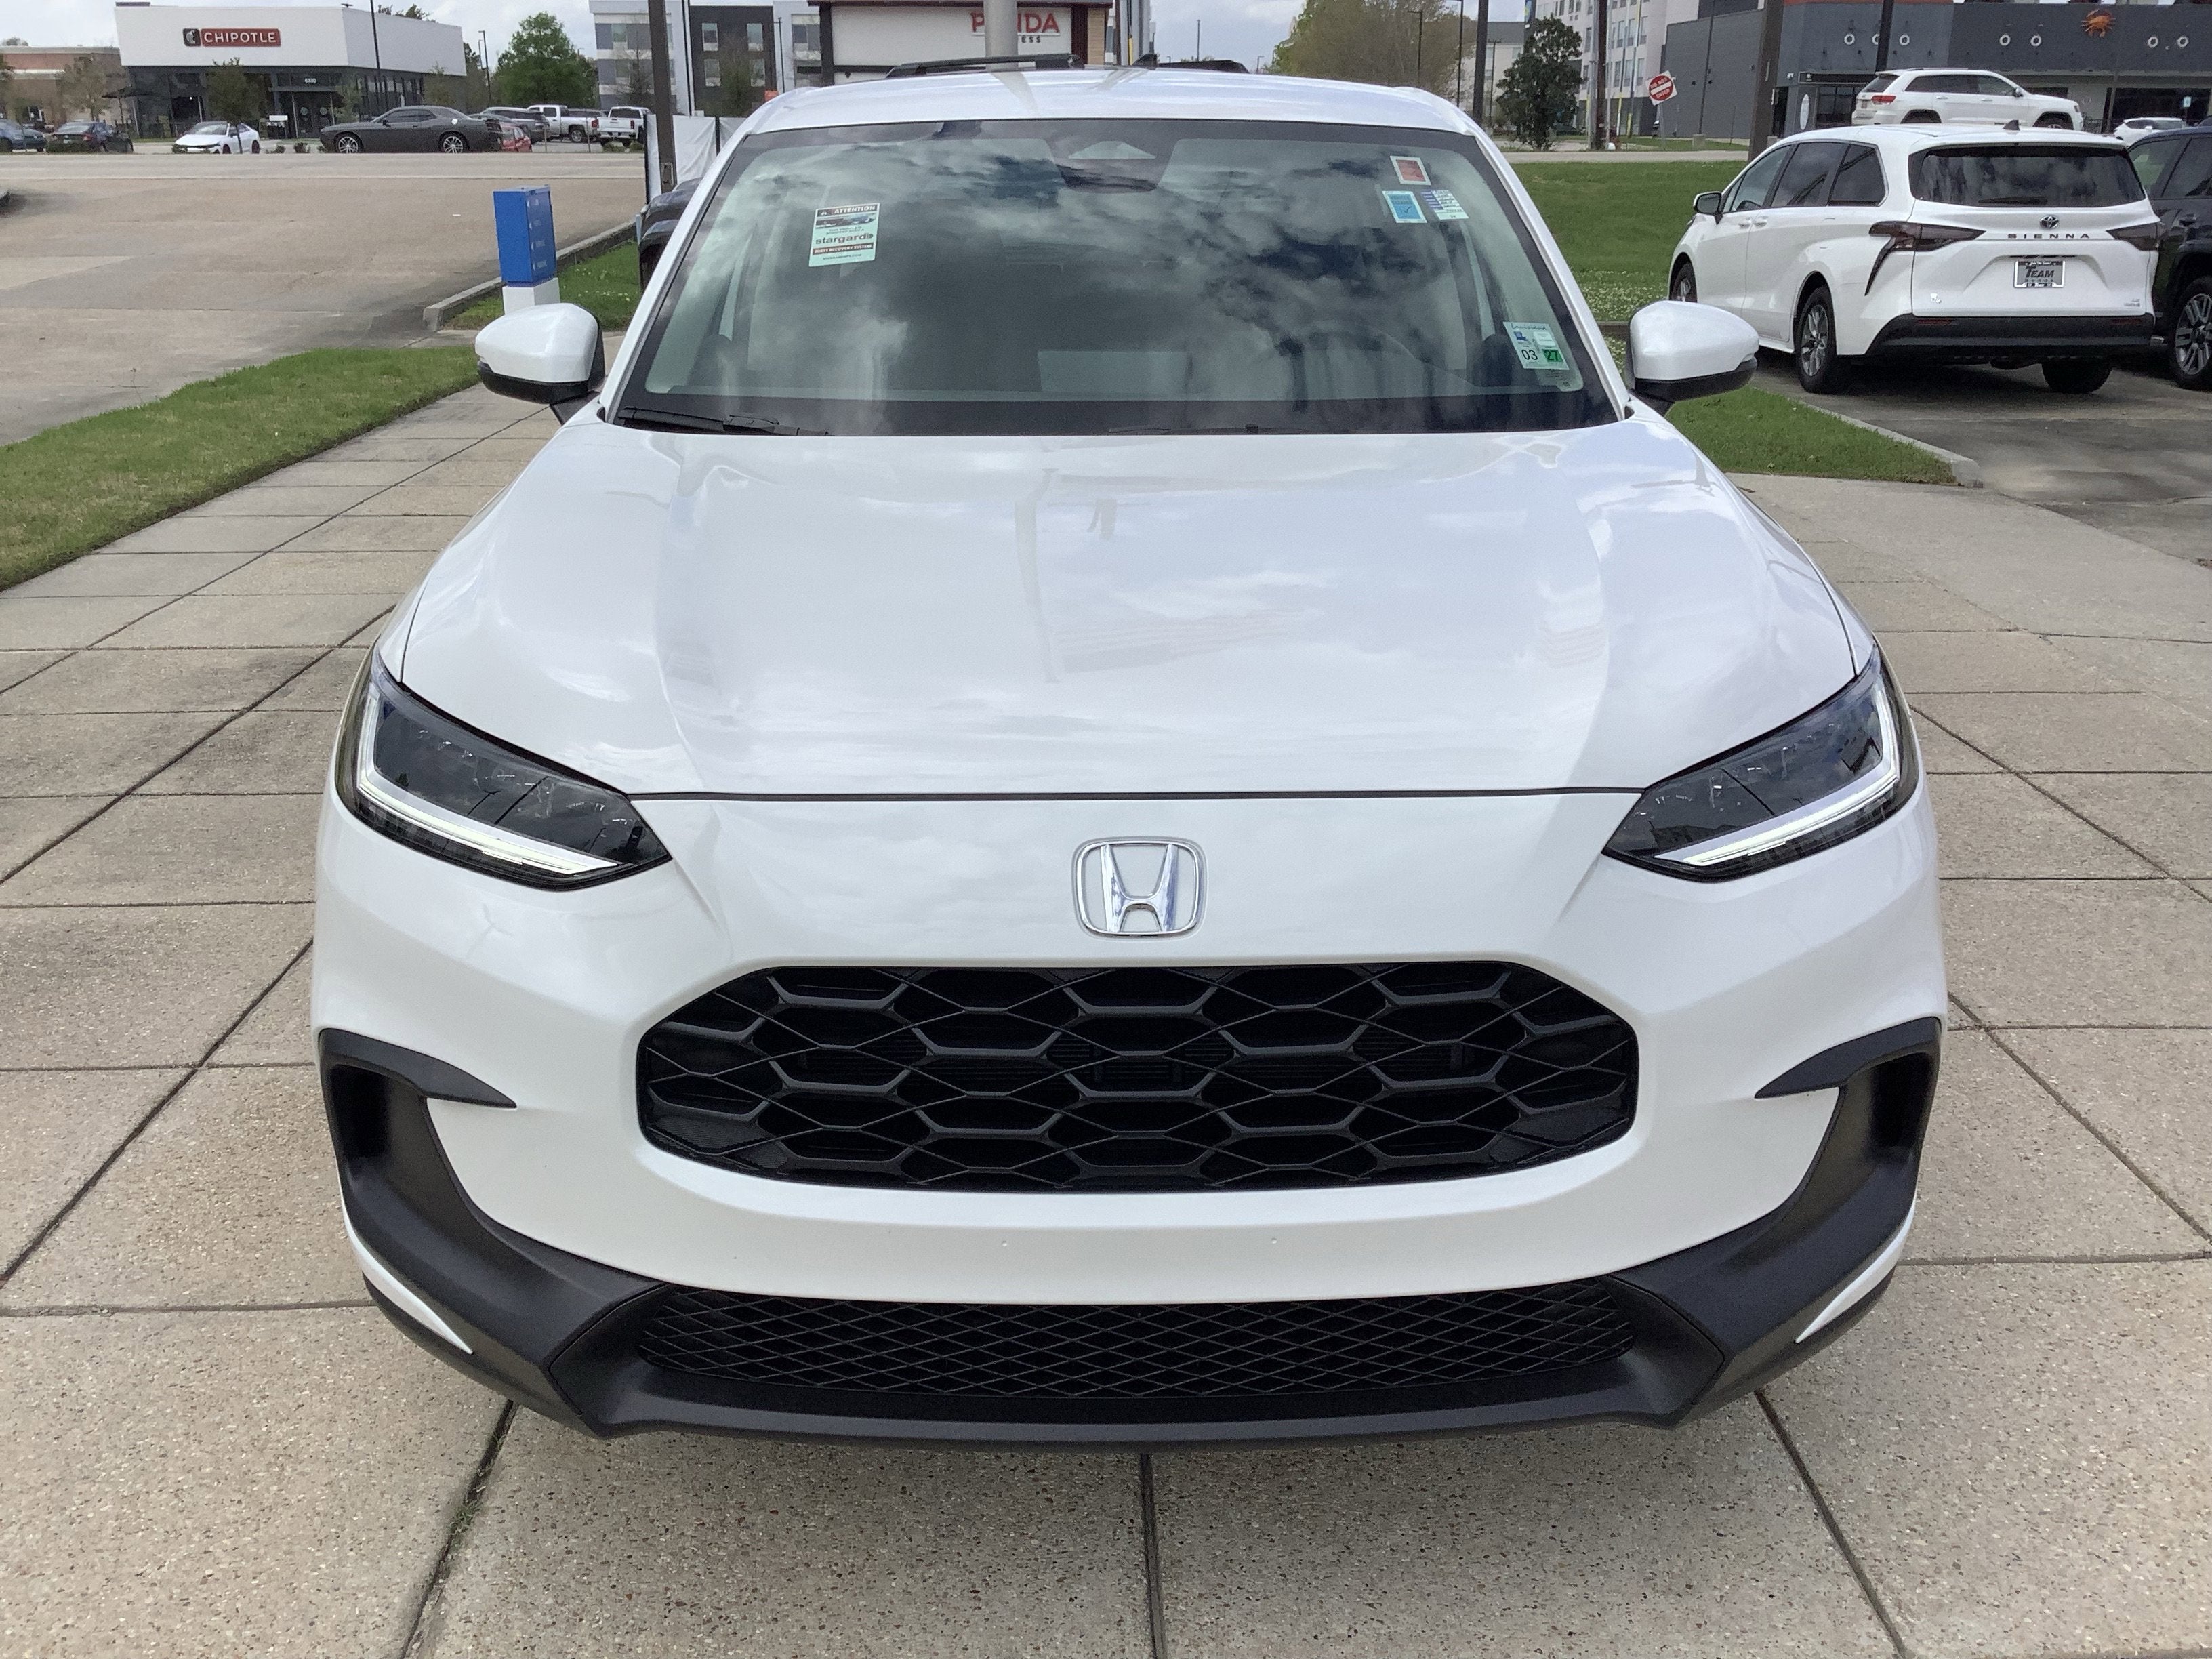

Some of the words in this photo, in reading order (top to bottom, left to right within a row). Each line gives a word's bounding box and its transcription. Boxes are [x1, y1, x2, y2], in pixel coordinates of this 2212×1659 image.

[970, 12, 1060, 33] PDA
[204, 32, 276, 43] CHIPOTLE
[834, 206, 876, 214] ATTENTION
[1521, 349, 1538, 361] 03
[1544, 350, 1559, 361] 27
